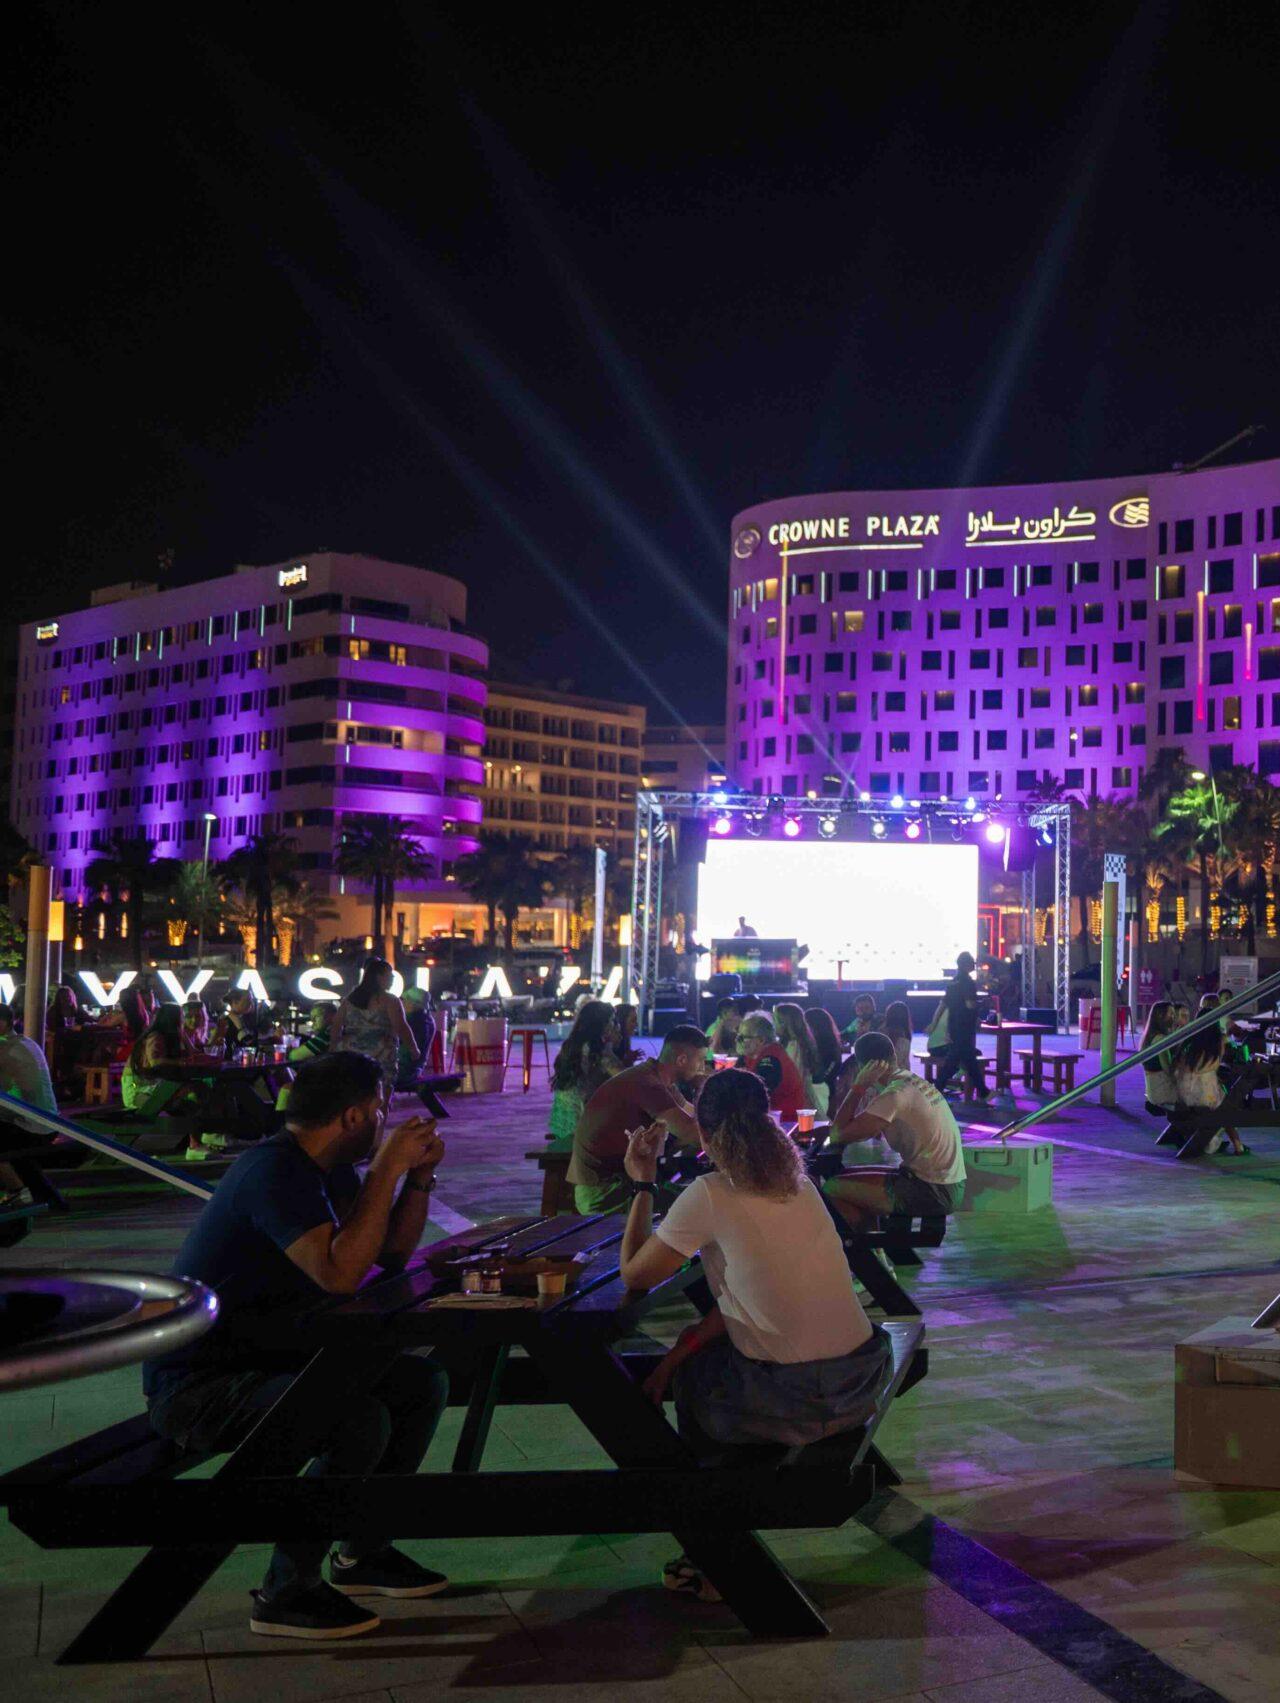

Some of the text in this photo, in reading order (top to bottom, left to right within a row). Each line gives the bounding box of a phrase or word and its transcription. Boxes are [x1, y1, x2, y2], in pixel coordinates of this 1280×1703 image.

[768, 514, 940, 546] CROWNE PLAZA
[1023, 506, 1096, 538] كراون
